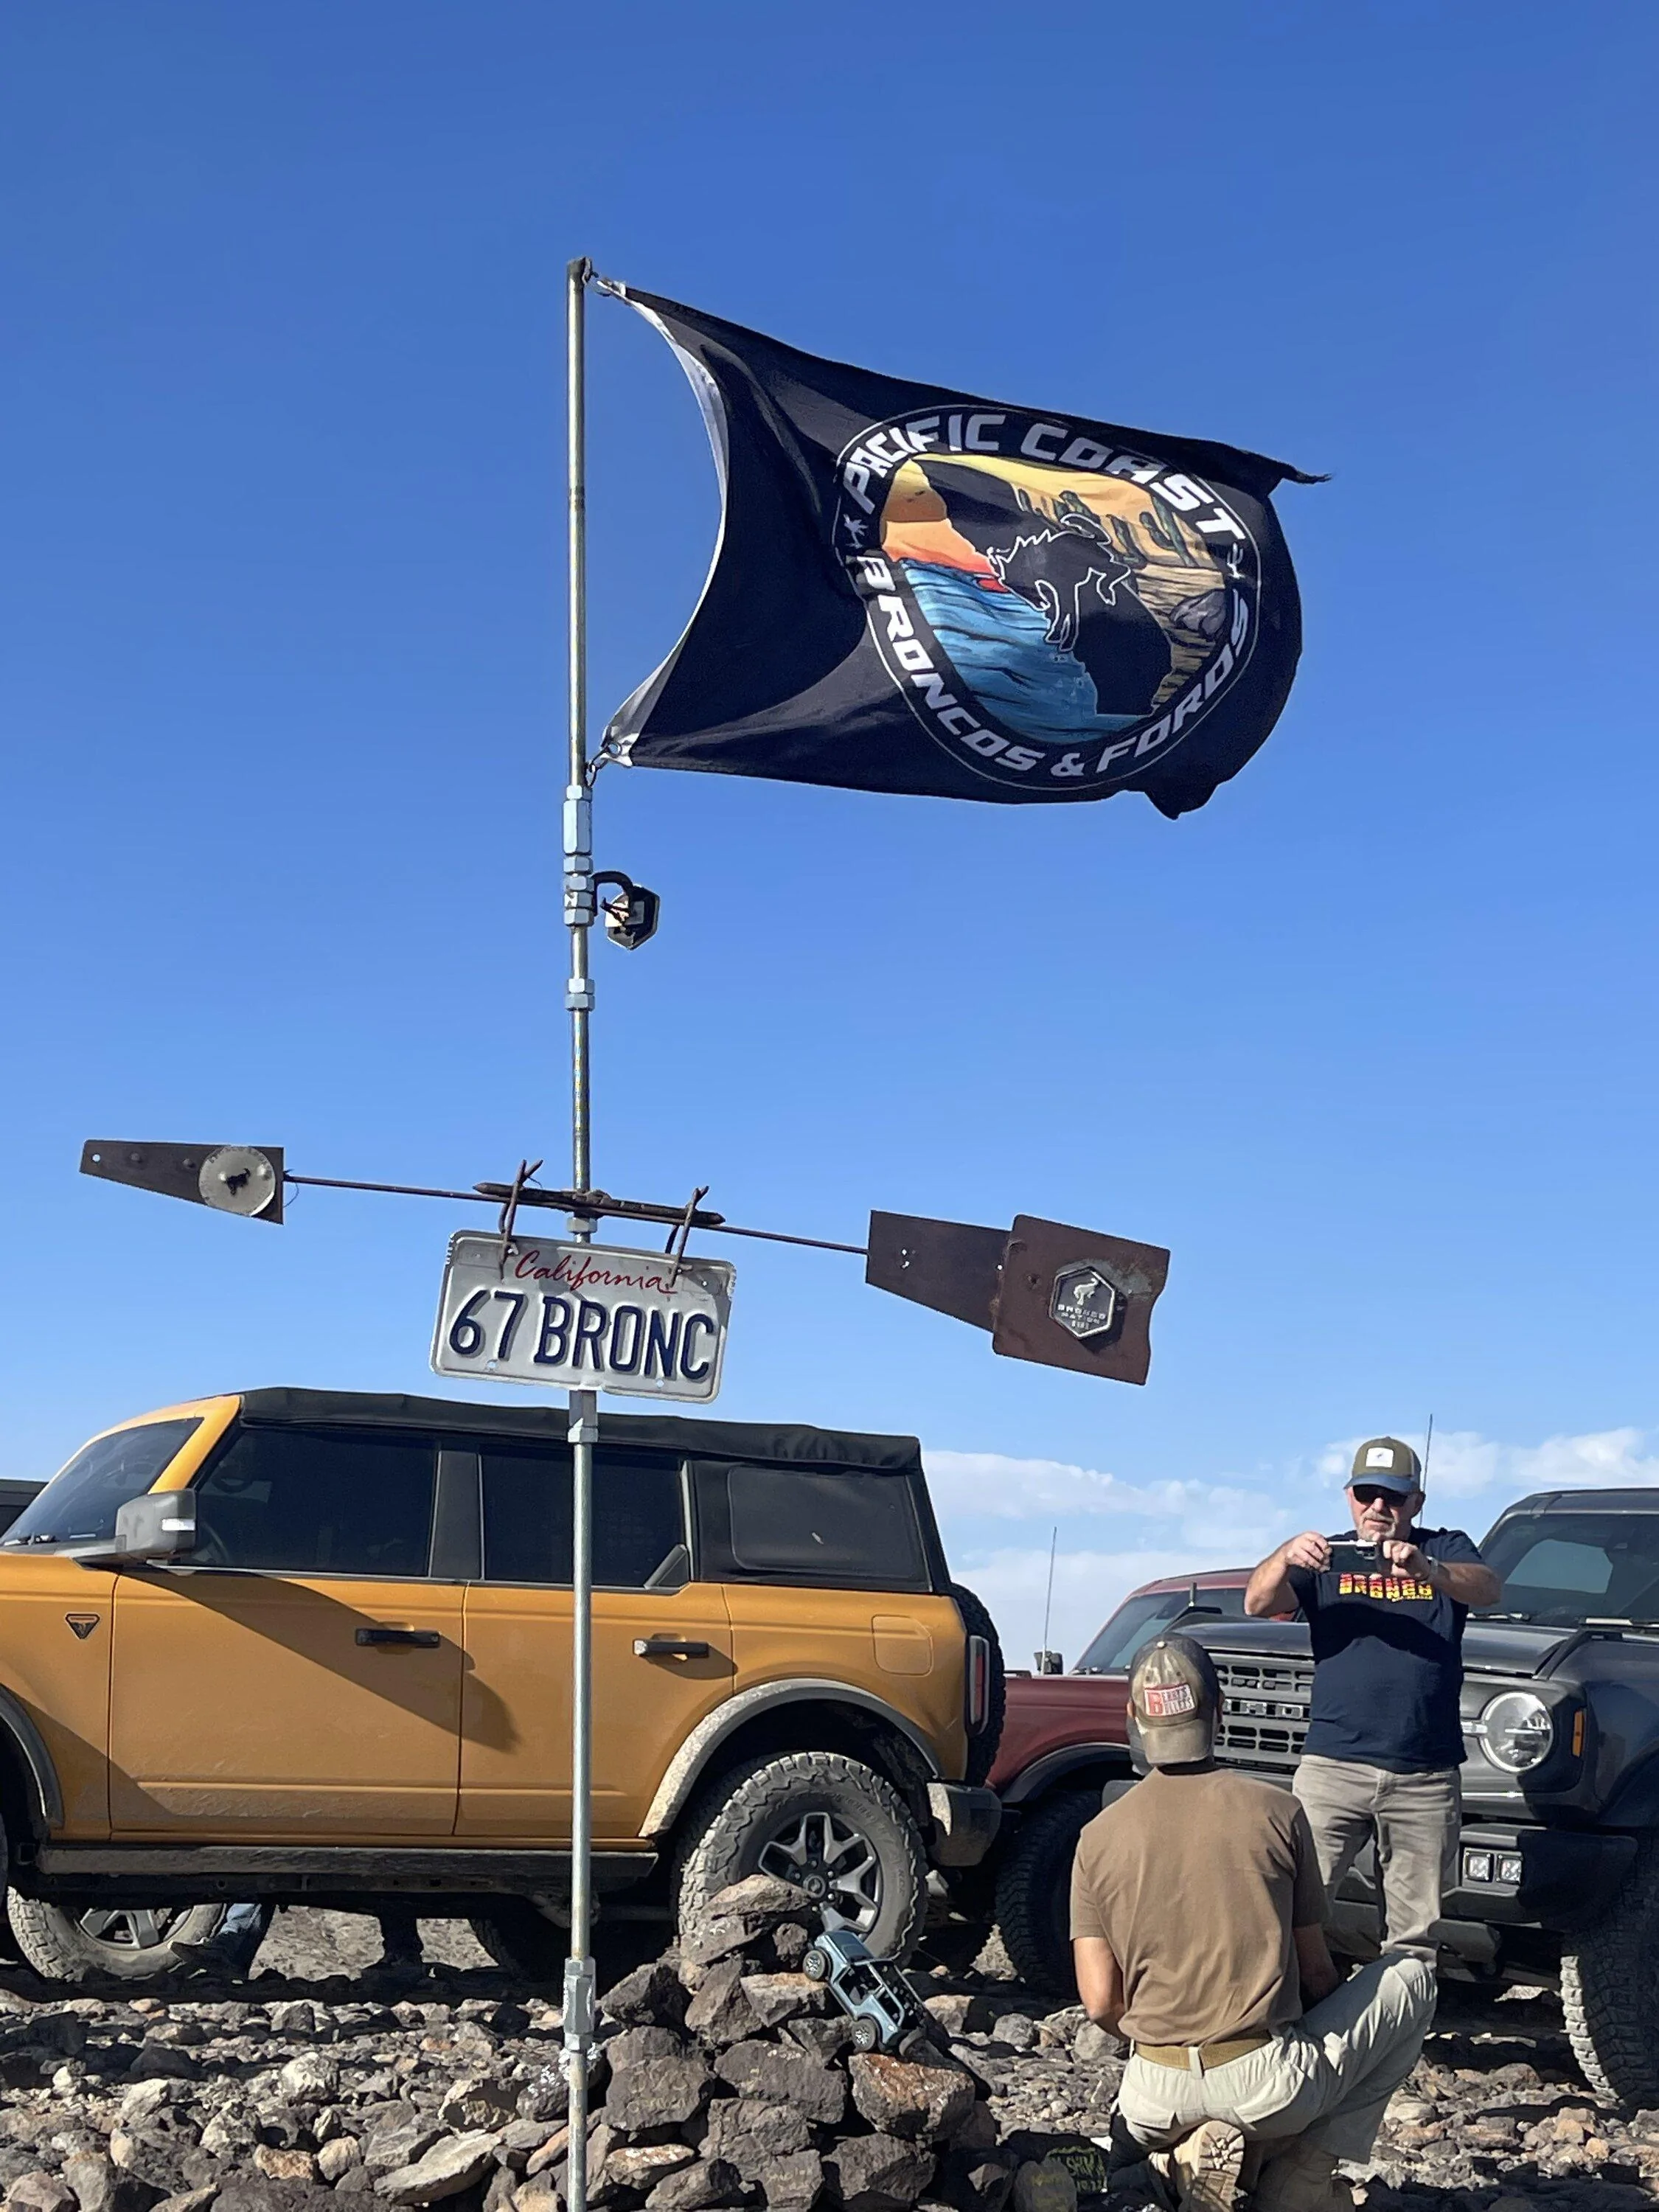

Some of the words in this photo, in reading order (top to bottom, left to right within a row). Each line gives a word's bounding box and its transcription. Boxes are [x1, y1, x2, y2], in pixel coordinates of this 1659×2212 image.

[844, 414, 1005, 514] PACIFIC
[1020, 423, 1245, 543] COAST
[856, 556, 1044, 772] BRONCOS
[1050, 752, 1085, 777] &
[1096, 589, 1248, 773] FORDS
[515, 1251, 678, 1294] California
[449, 1289, 526, 1362] 67
[532, 1295, 715, 1380] BRONC
